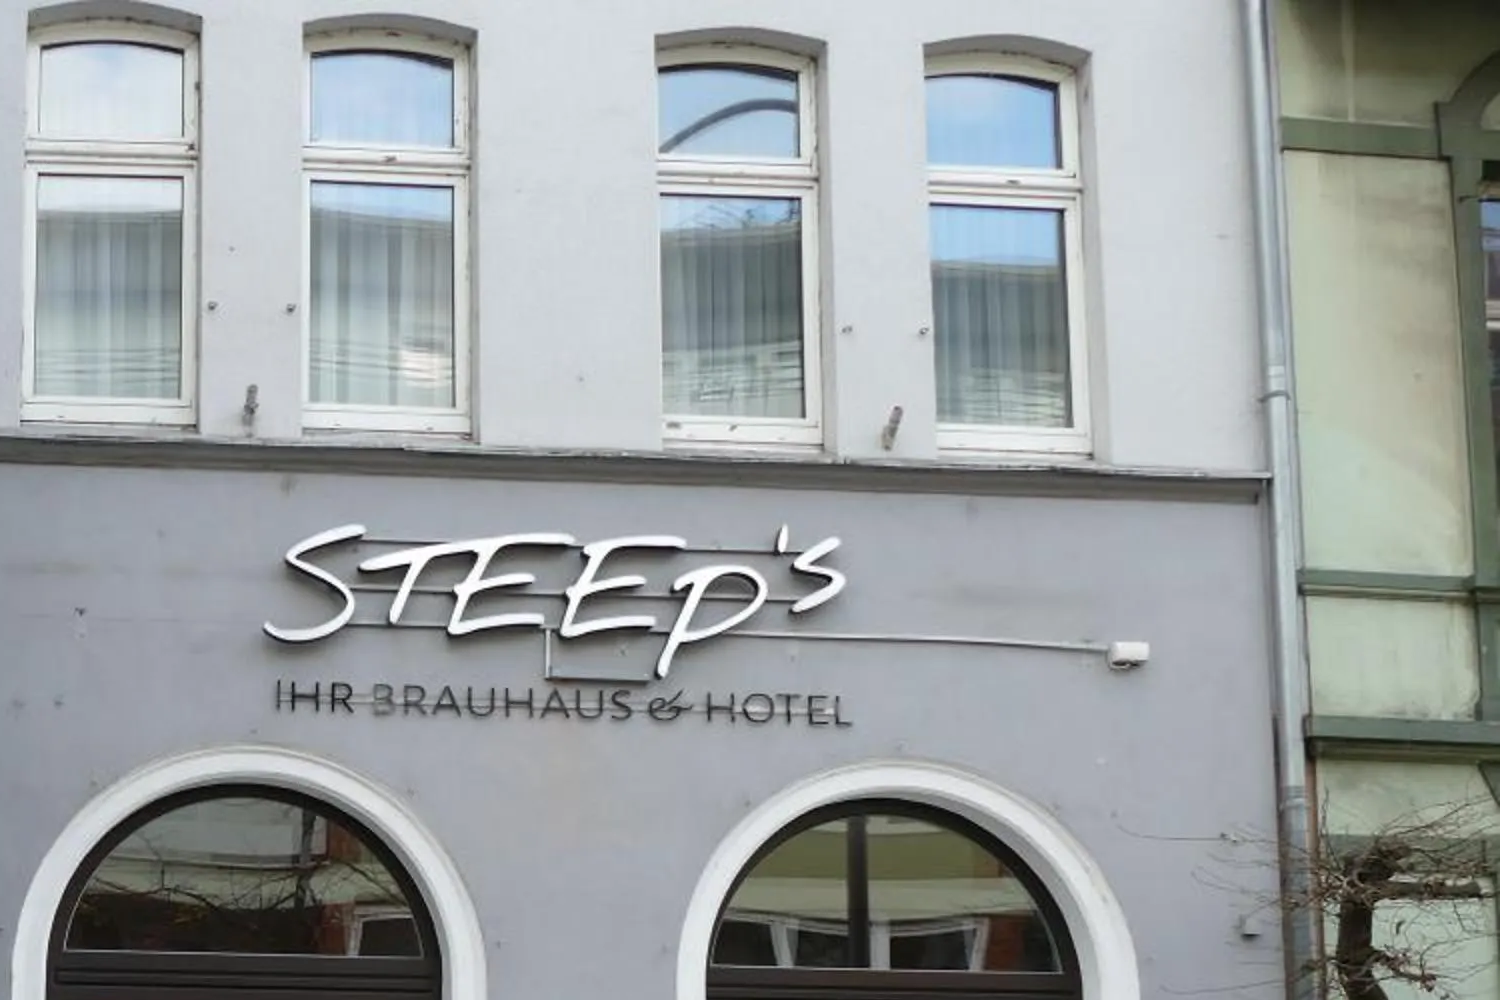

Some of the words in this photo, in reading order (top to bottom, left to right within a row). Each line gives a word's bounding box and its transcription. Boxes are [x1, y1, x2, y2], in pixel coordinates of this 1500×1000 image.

[275, 679, 355, 714] IHR
[371, 683, 633, 722] BRAUHAUS
[649, 689, 694, 721] &
[706, 692, 853, 728] HOTEL
